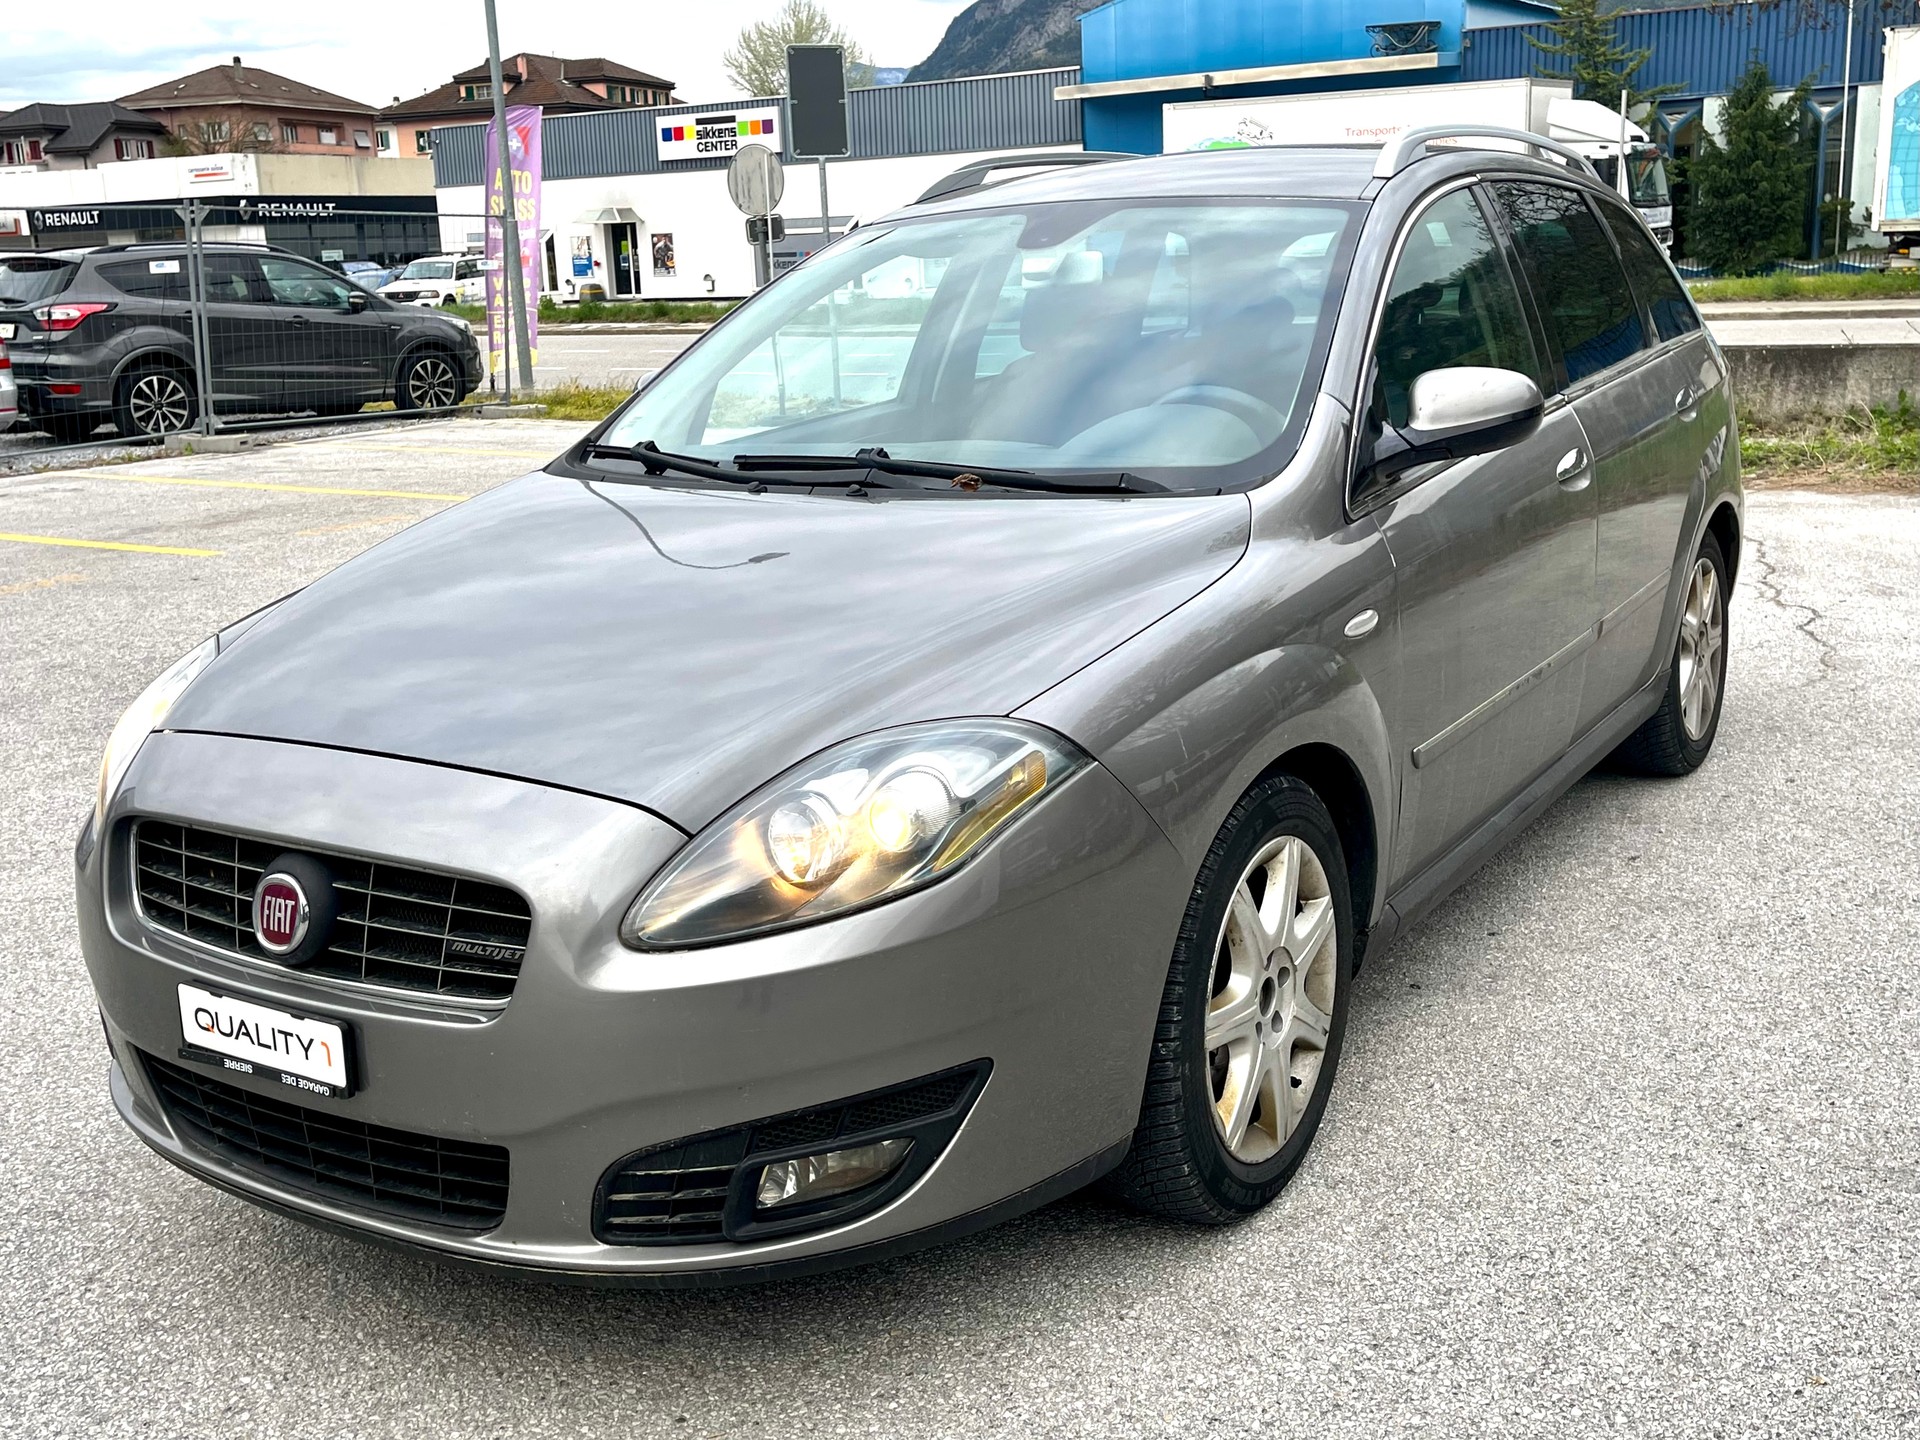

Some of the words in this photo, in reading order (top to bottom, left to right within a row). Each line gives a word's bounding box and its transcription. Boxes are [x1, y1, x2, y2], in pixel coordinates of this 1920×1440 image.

[696, 126, 737, 140] sikkens
[696, 140, 738, 152] CENTER
[494, 168, 532, 194] ATO
[258, 203, 336, 216] RENAULT
[45, 210, 99, 226] RENAULT
[264, 895, 295, 933] FIAT
[451, 941, 525, 960] MULTIJET
[223, 1058, 253, 1073] SIERRE
[281, 1073, 297, 1086] DES
[298, 1078, 330, 1096] GARAGE
